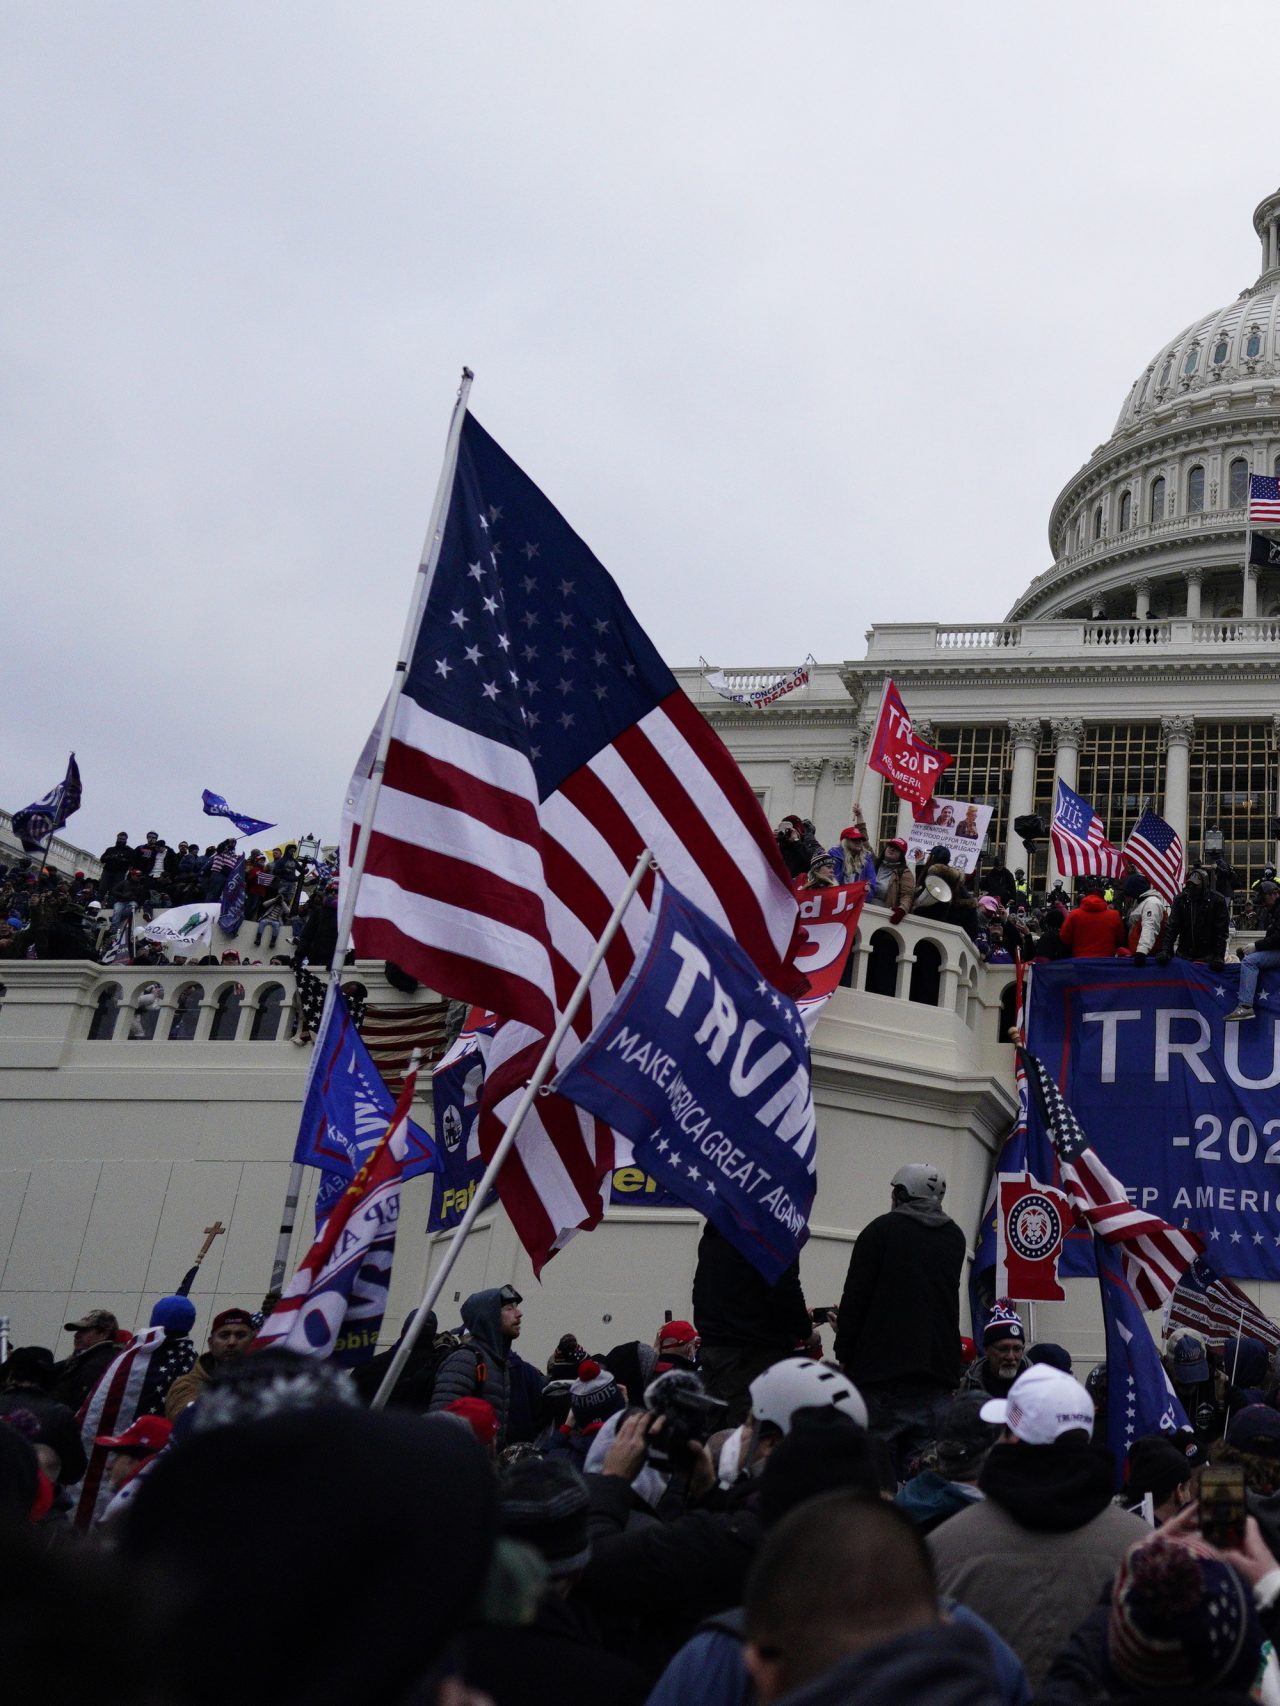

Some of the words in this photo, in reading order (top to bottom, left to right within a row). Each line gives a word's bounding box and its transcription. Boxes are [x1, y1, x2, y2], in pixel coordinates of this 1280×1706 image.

[750, 678, 788, 700] CONCEDE
[792, 666, 804, 678] TO
[754, 670, 810, 710] TREASON
[664, 930, 817, 1176] TRUM
[606, 1026, 677, 1088] MAKE
[700, 1130, 773, 1194] GREAT
[1125, 1187, 1160, 1211] EP
